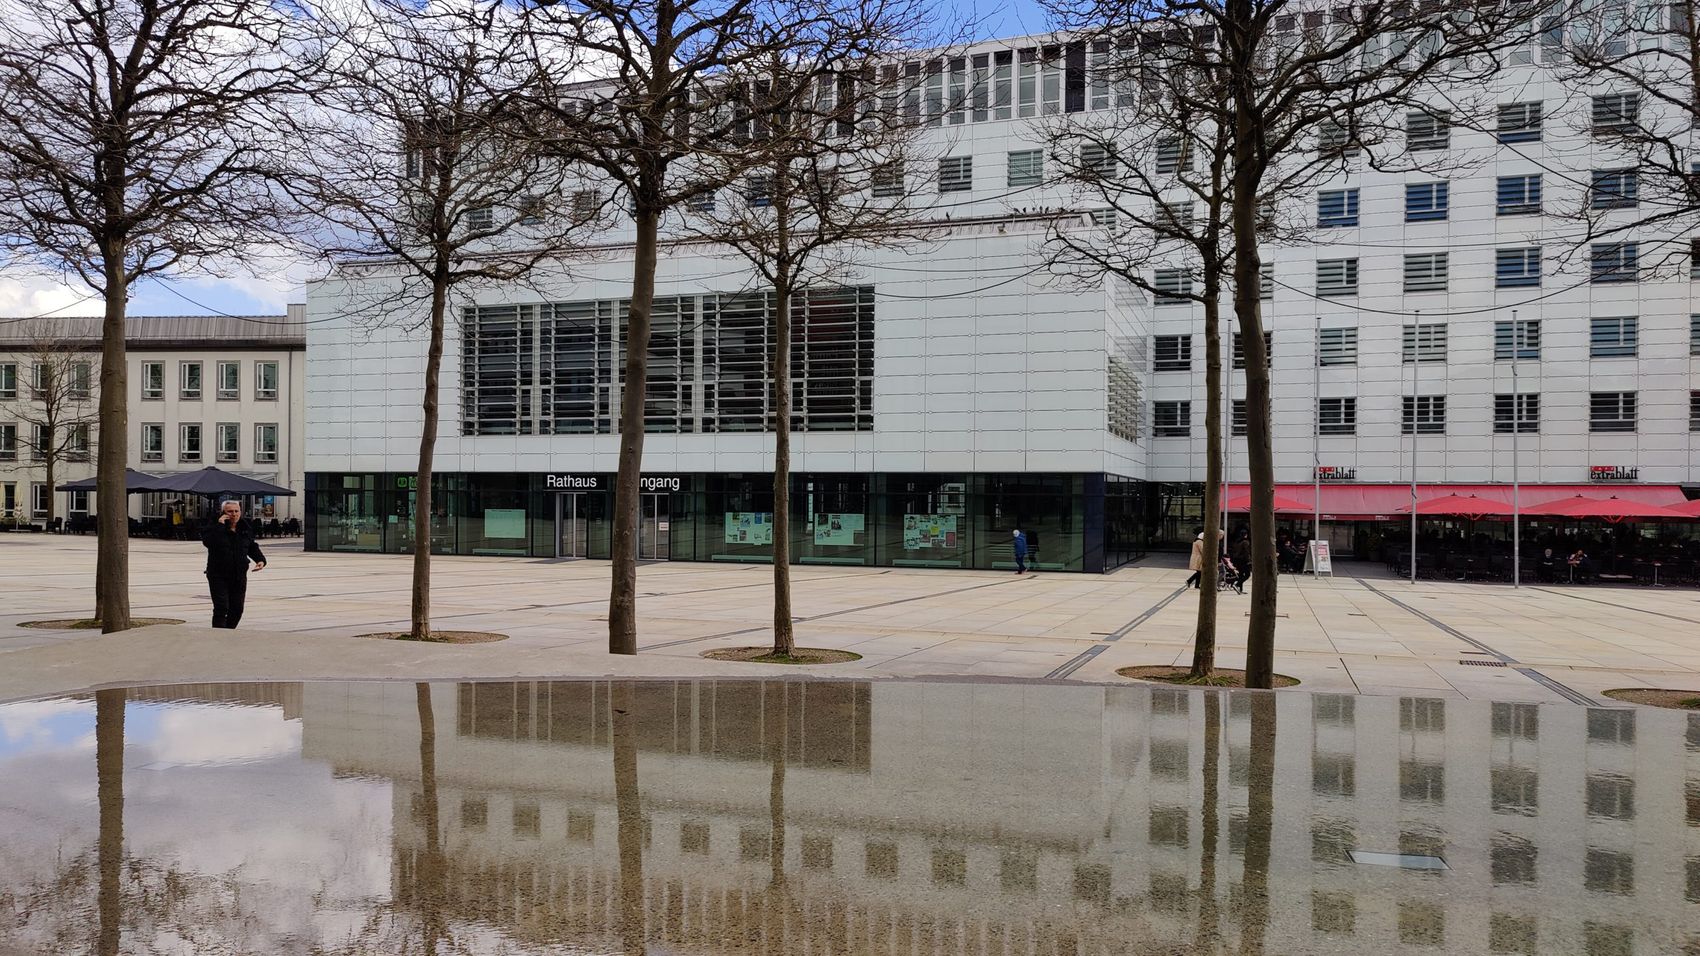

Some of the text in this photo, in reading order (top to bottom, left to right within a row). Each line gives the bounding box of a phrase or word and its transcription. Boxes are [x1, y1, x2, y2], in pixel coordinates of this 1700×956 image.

[1590, 466, 1639, 480] extrablatt
[547, 474, 680, 491] Rathaus ngang
